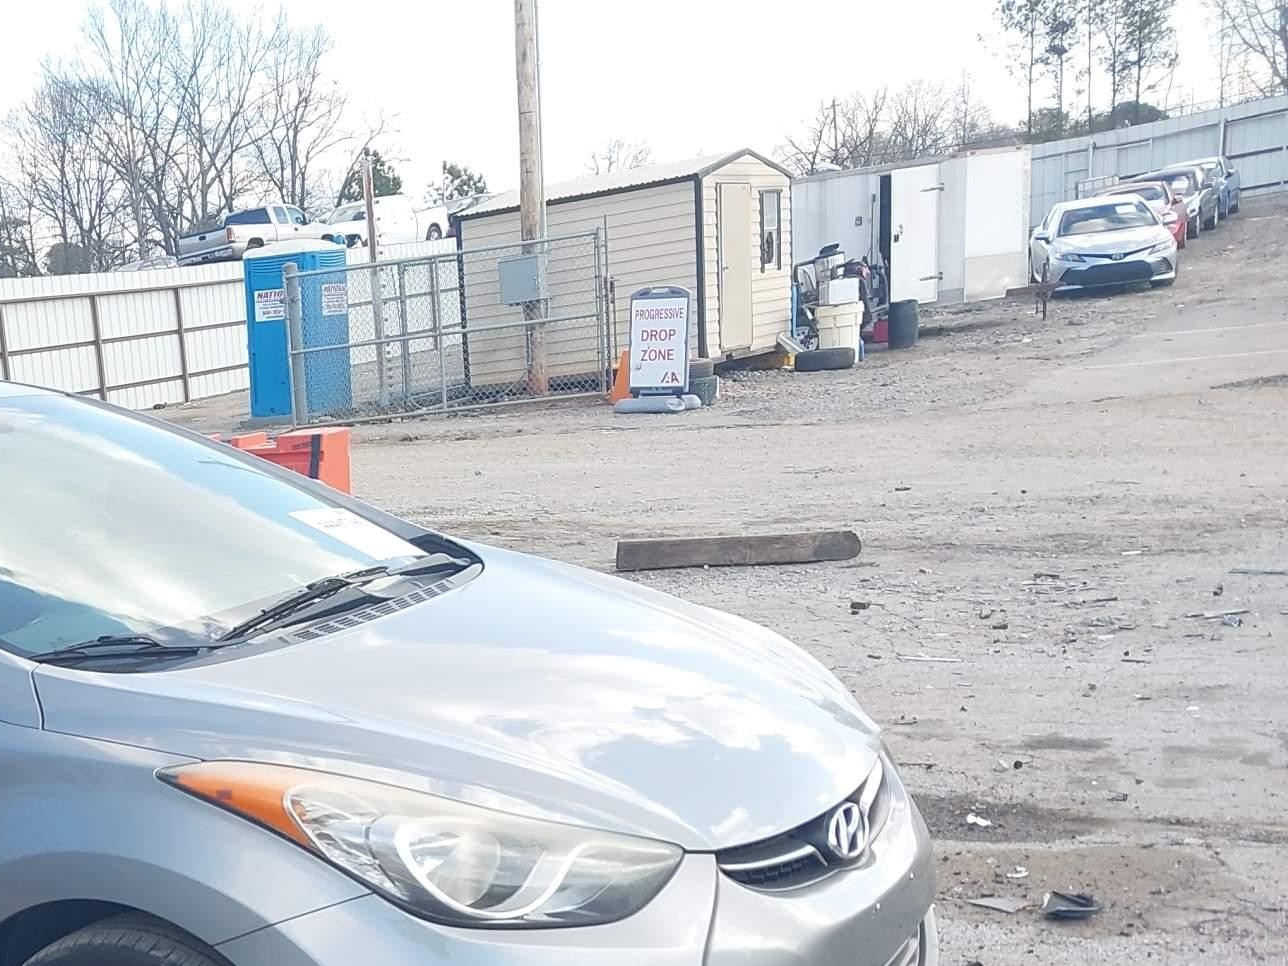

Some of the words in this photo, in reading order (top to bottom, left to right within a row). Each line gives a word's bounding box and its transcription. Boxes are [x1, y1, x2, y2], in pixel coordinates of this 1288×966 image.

[635, 307, 685, 320] PROGRESSIVE
[641, 329, 676, 342] DROP
[640, 348, 675, 362] ZONE
